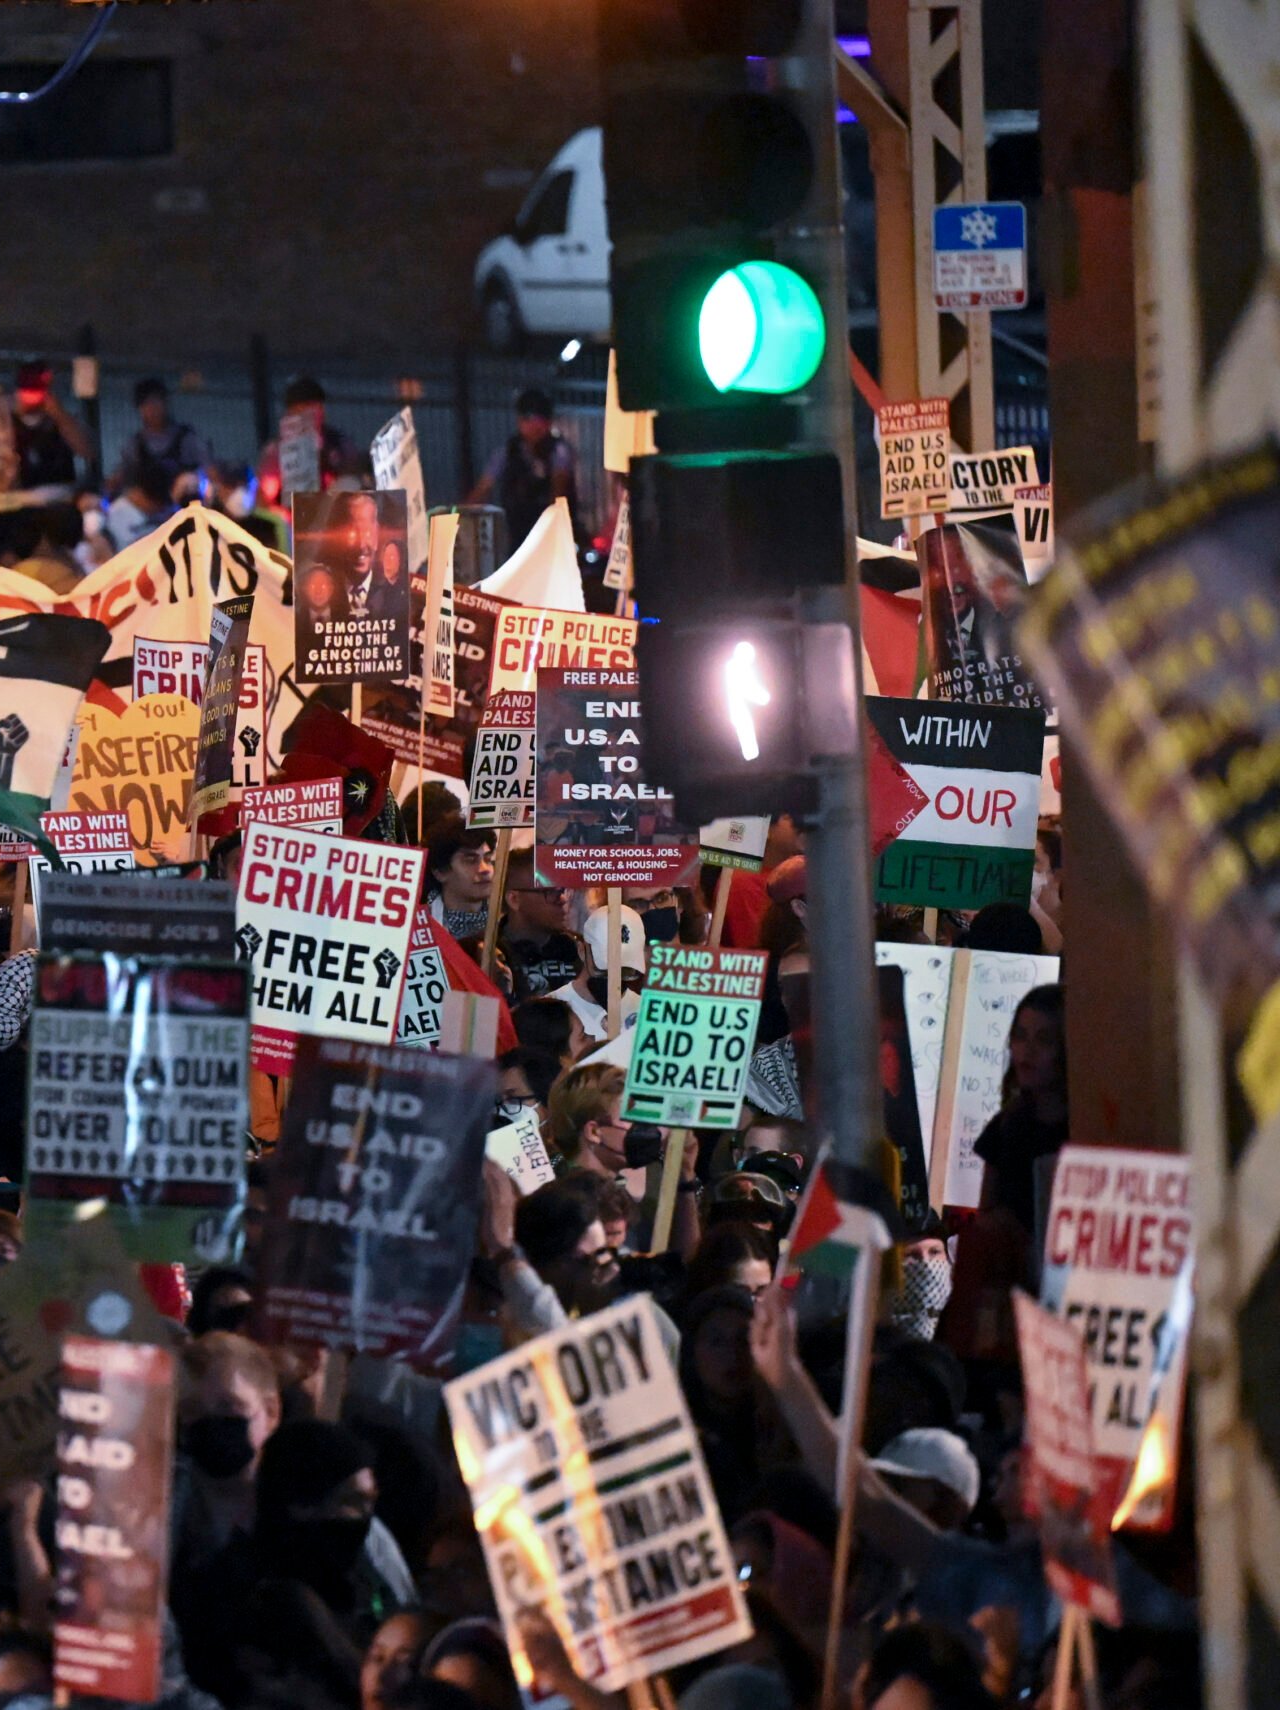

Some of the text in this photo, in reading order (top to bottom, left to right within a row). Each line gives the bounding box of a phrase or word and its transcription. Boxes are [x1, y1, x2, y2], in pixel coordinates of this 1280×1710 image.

[880, 399, 947, 420] STAND WITH
[881, 414, 947, 433] PALESTINE!
[885, 433, 944, 454] END U.S
[885, 452, 946, 475] AID TO
[885, 474, 946, 494] ISRAEL!
[315, 619, 396, 635] DEMOCRATS
[503, 615, 634, 646] STOP POLICE
[325, 633, 387, 647] FUND THE
[138, 649, 183, 670] STOP
[308, 646, 400, 661] GENOCIDE OF
[305, 660, 403, 675] PALESTINIANS
[564, 672, 596, 684] FREE
[940, 671, 1014, 698] FUND THE
[139, 701, 185, 719] YOU!
[222, 703, 235, 717] ON
[489, 694, 531, 709] STAND
[481, 733, 522, 752] END
[565, 729, 611, 745] U.S.
[900, 716, 992, 749] WITHIN
[477, 755, 517, 776] AID
[599, 756, 638, 772] TO
[244, 782, 340, 807] STAND WITH
[562, 784, 674, 800] ISRAEL
[902, 777, 924, 801] NOW
[245, 802, 340, 822] PALESTINE!
[934, 784, 1017, 828] OUR
[39, 814, 127, 832] TAND WITH
[896, 808, 917, 833] OUT
[45, 832, 130, 852] LESTINE!
[252, 833, 417, 884] STOP POLICE
[554, 849, 586, 858] MONEY
[589, 849, 608, 858] FOR
[610, 848, 655, 859] SCHOOLS,
[720, 854, 731, 866] AID
[732, 857, 740, 867] TO
[555, 860, 668, 871] HEALTHCARE, & HOUSING
[878, 853, 1023, 899] LIFETIME
[583, 872, 653, 882] NOT GENOCIDE!
[243, 862, 411, 929] CRIMES
[263, 928, 371, 986] FREE
[651, 946, 765, 974] STAND WITH
[647, 968, 762, 997] PALESTINE!
[252, 973, 389, 1029] HEM ALL
[408, 981, 445, 1008] TO
[645, 999, 749, 1031] END U.S
[639, 1029, 745, 1062] AID TO
[634, 1058, 740, 1092] ISRAEL!
[34, 1110, 237, 1148] OVER OLICE
[1051, 1206, 1191, 1281] CRIMES
[464, 1311, 652, 1450] VICORY
